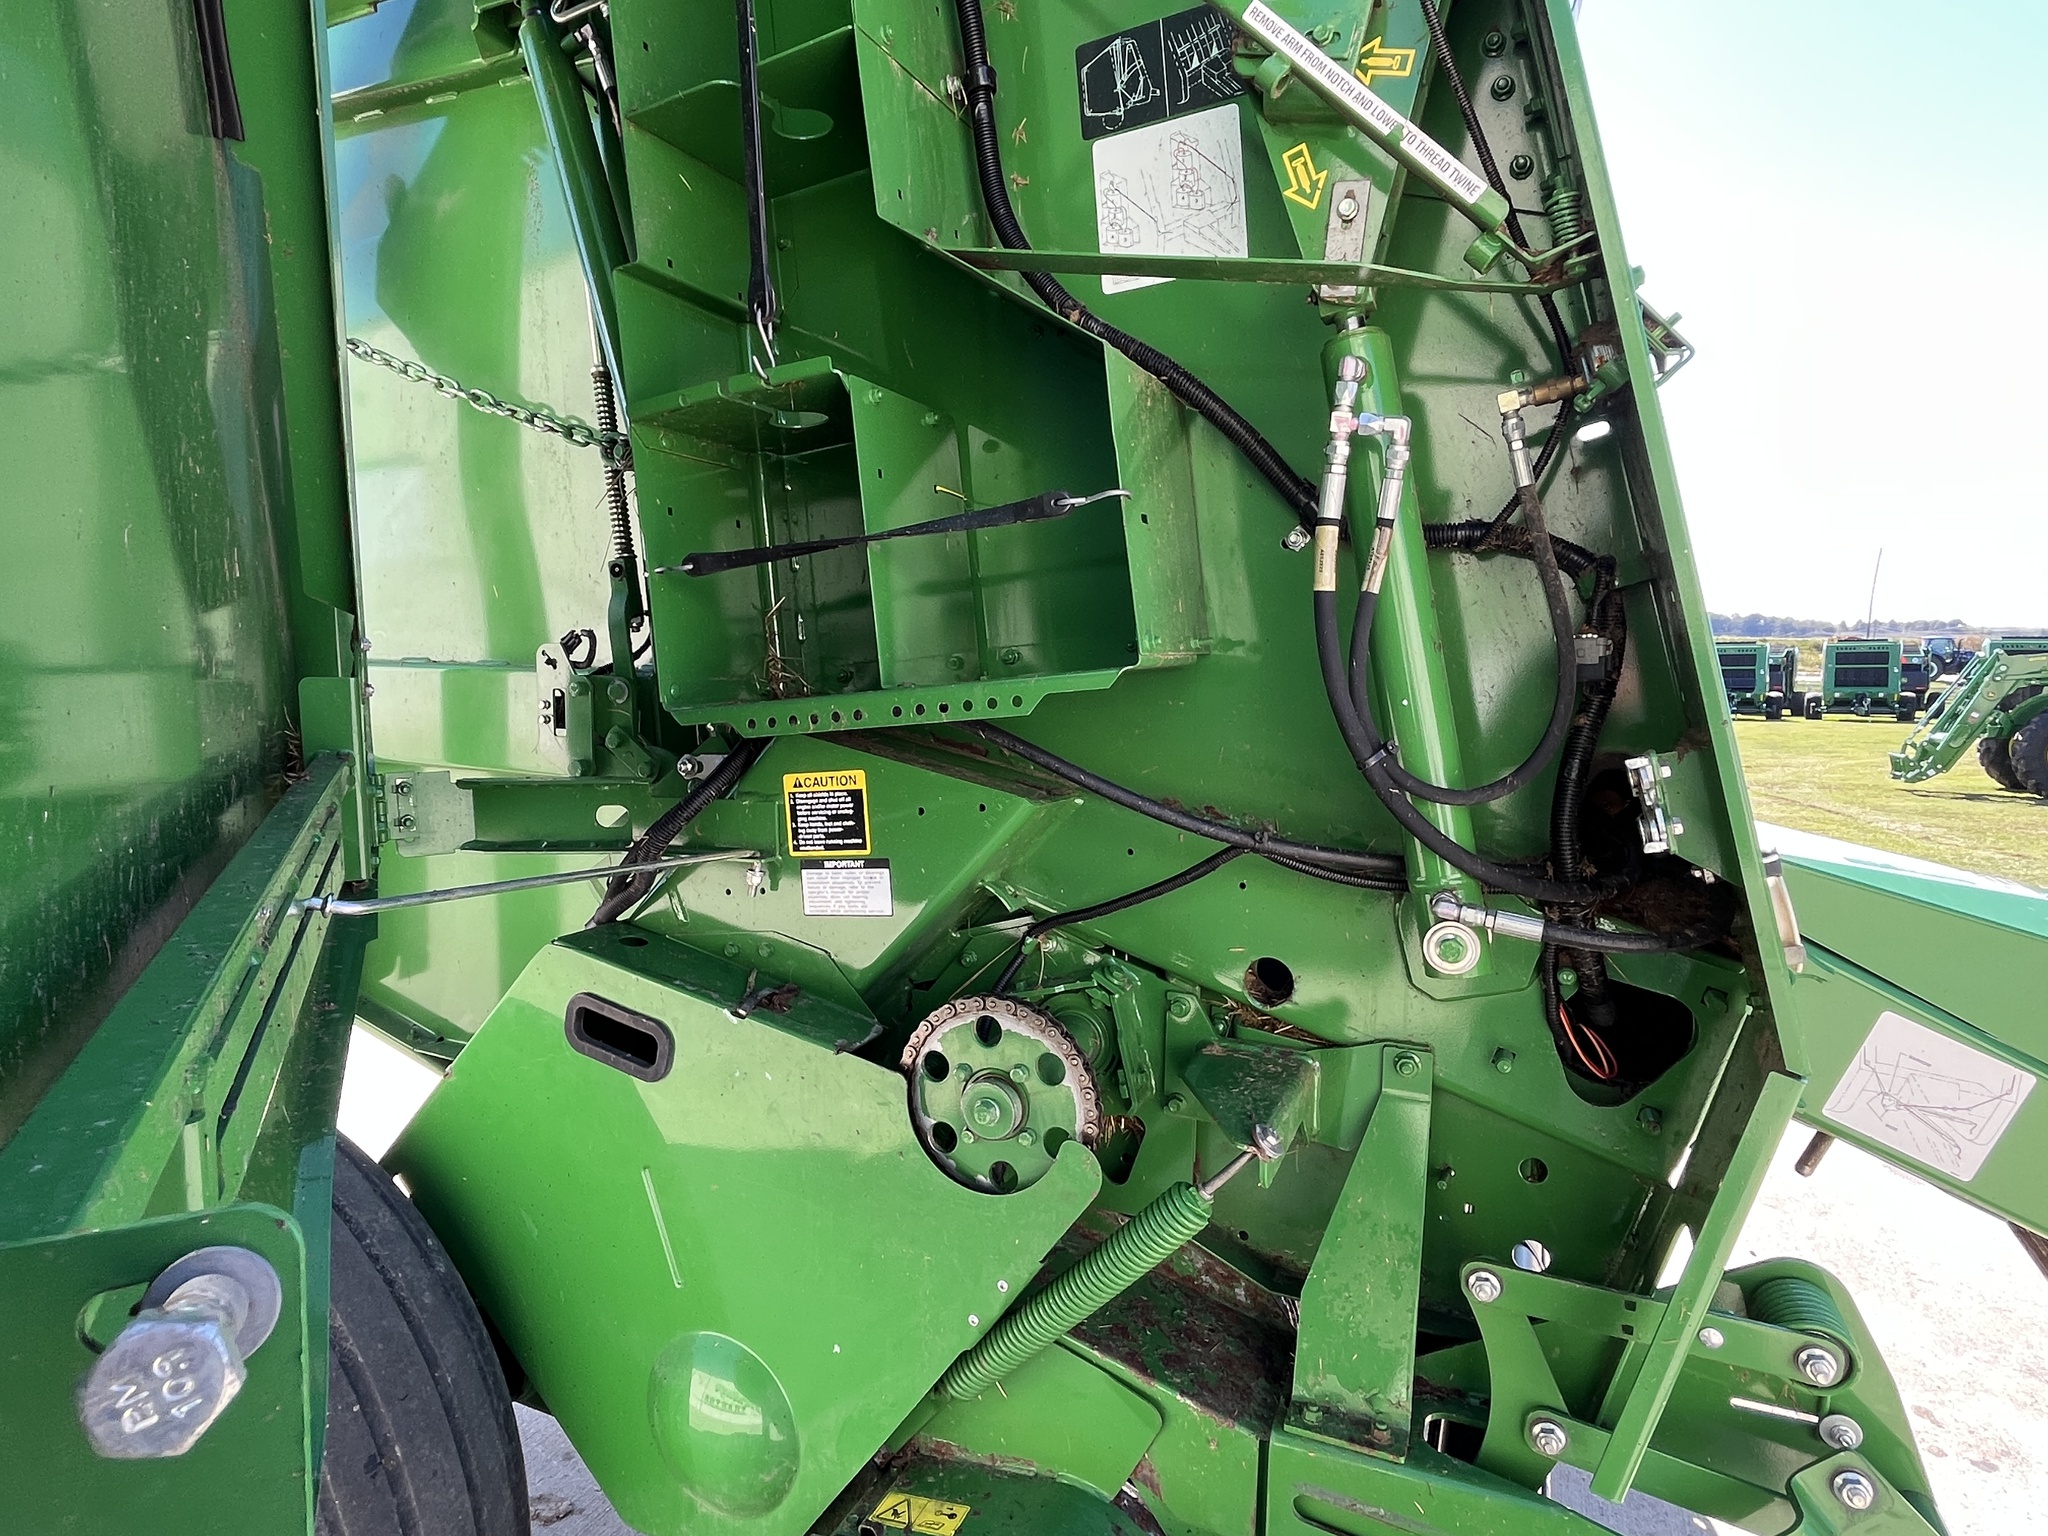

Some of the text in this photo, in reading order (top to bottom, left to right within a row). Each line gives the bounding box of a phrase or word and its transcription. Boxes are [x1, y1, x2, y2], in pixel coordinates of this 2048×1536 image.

[1248, 6, 1480, 197] REMOVE ARM FROM NOTCH AND LOWE TO THREAD TWINE
[804, 775, 857, 788] CAUTION
[823, 860, 866, 869] IMPORTANT
